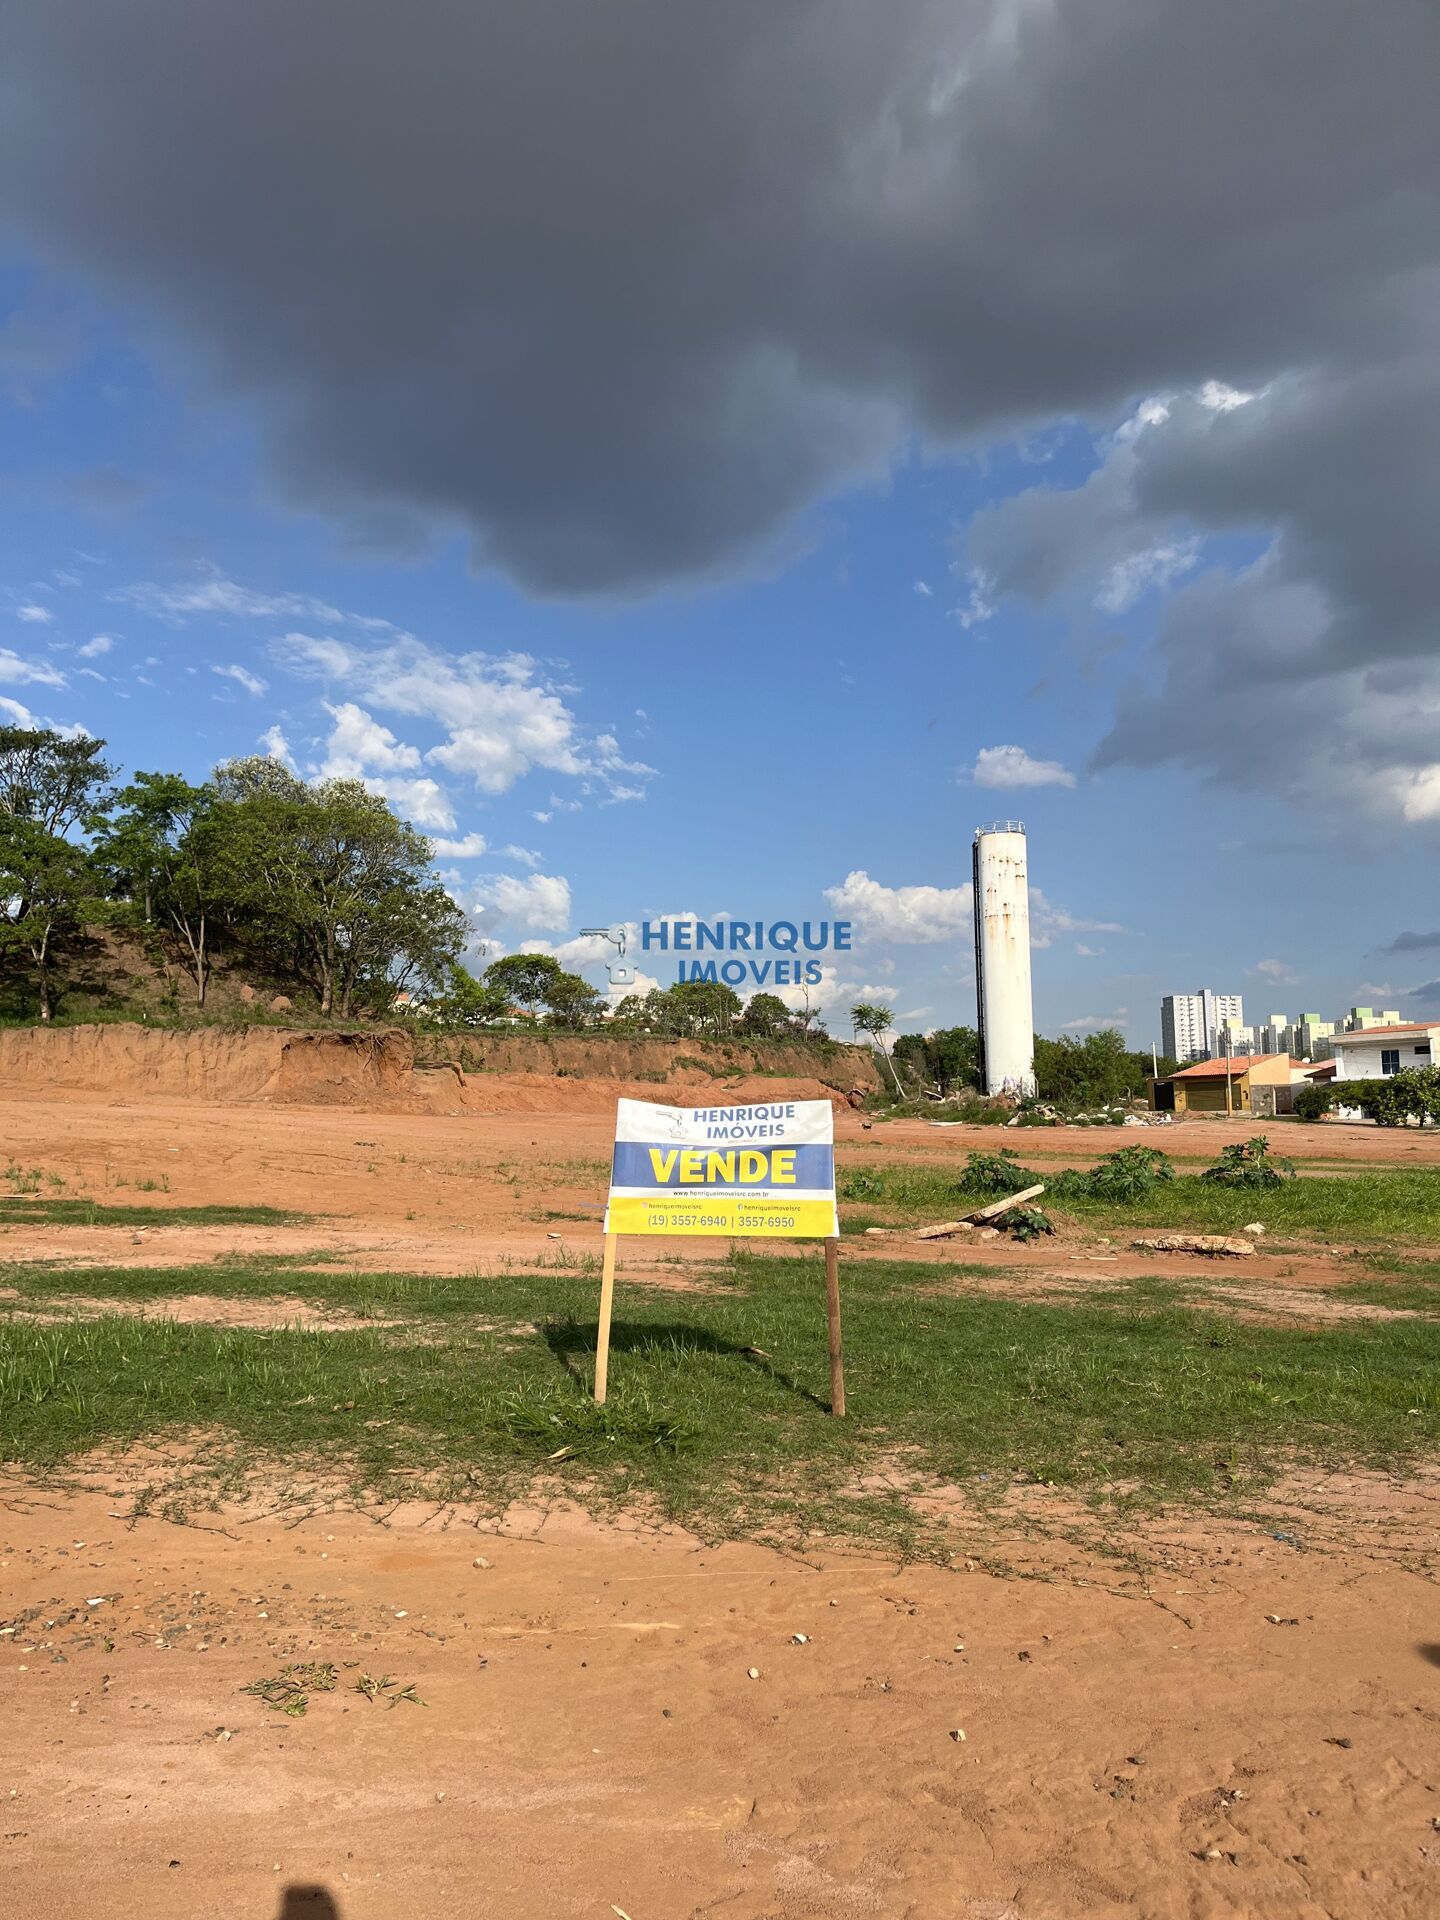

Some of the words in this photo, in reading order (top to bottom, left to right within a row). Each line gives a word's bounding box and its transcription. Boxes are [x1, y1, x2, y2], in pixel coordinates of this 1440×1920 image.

[693, 1105, 795, 1122] HENRIQUE
[707, 1122, 785, 1139] IMÓVEIS
[648, 1149, 797, 1184] VENDE
[648, 1214, 669, 1227] (19)
[671, 1215, 727, 1227] 3557-6940
[738, 1216, 795, 1228] 3557-6950
